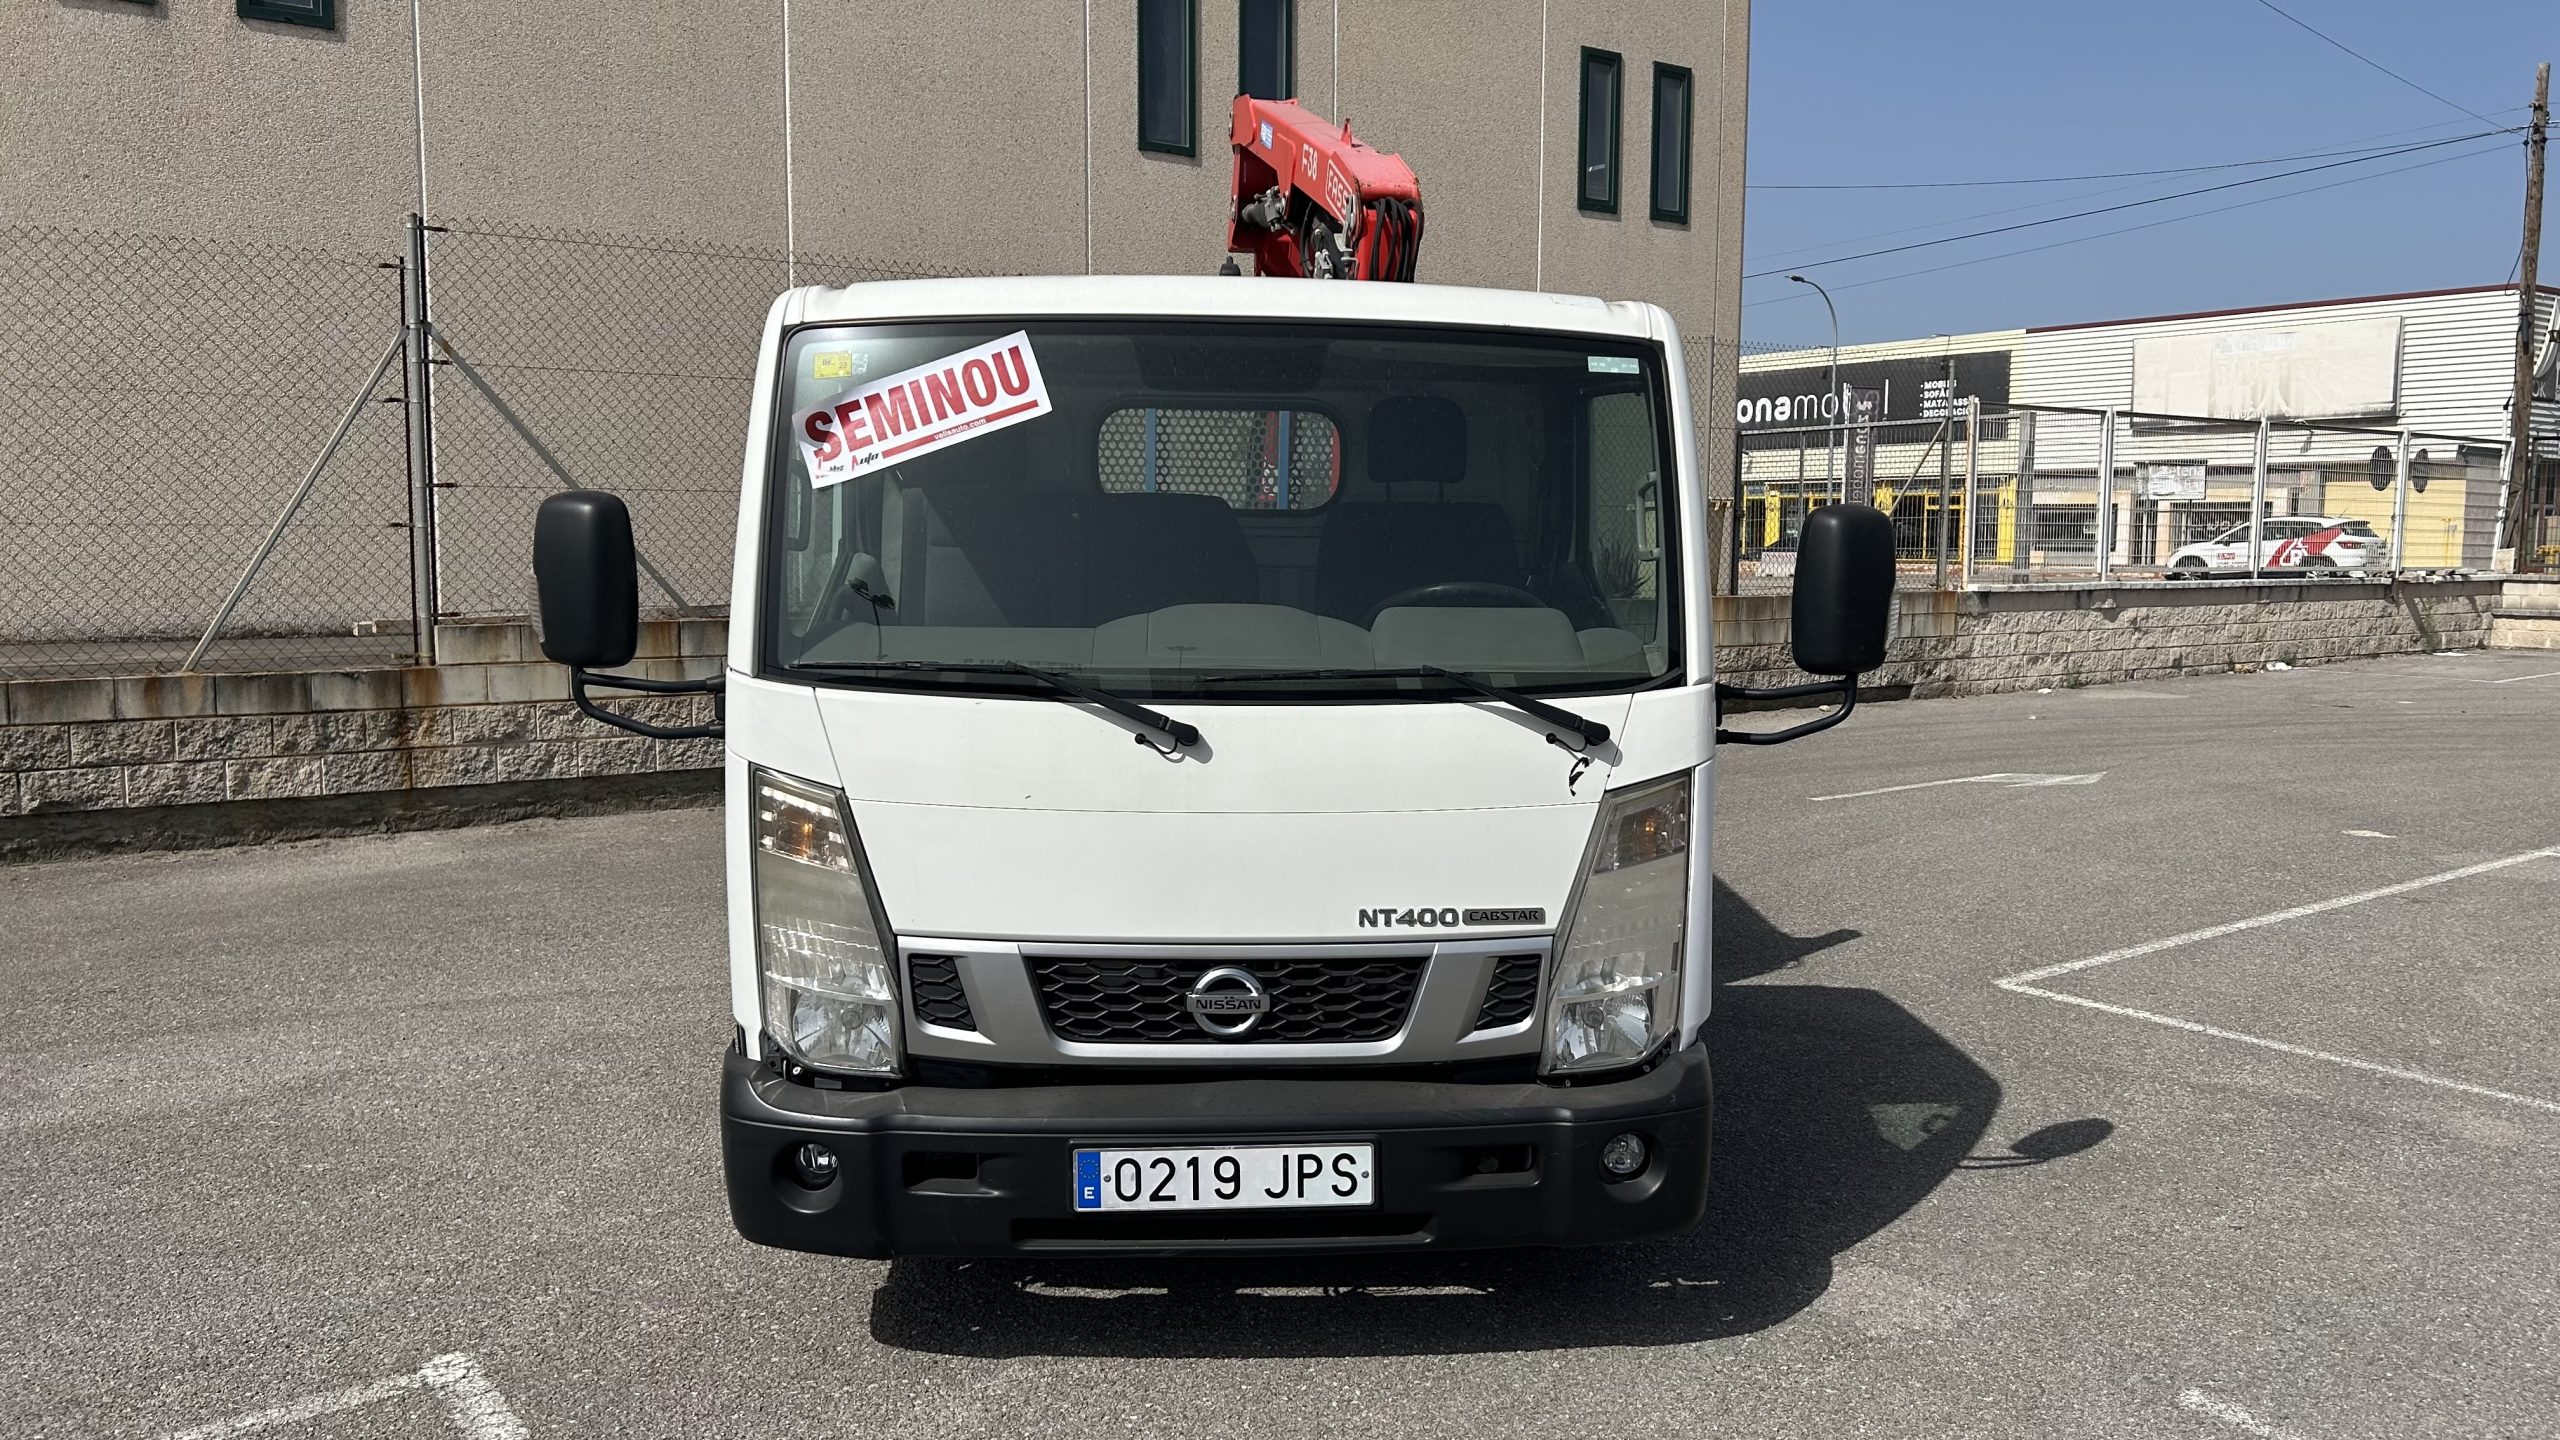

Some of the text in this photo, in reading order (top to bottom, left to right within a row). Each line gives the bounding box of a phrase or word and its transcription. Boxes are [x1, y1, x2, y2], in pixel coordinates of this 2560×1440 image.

[1302, 143, 1318, 181] F38
[1328, 169, 1348, 216] FASS
[805, 345, 1030, 462] SEMINOU
[1358, 907, 1539, 928] NT400 CABSTAR
[1195, 1000, 1261, 1010] NISSAN
[1084, 1187, 1095, 1199] E
[1114, 1153, 1358, 1202] 0219 JPS
